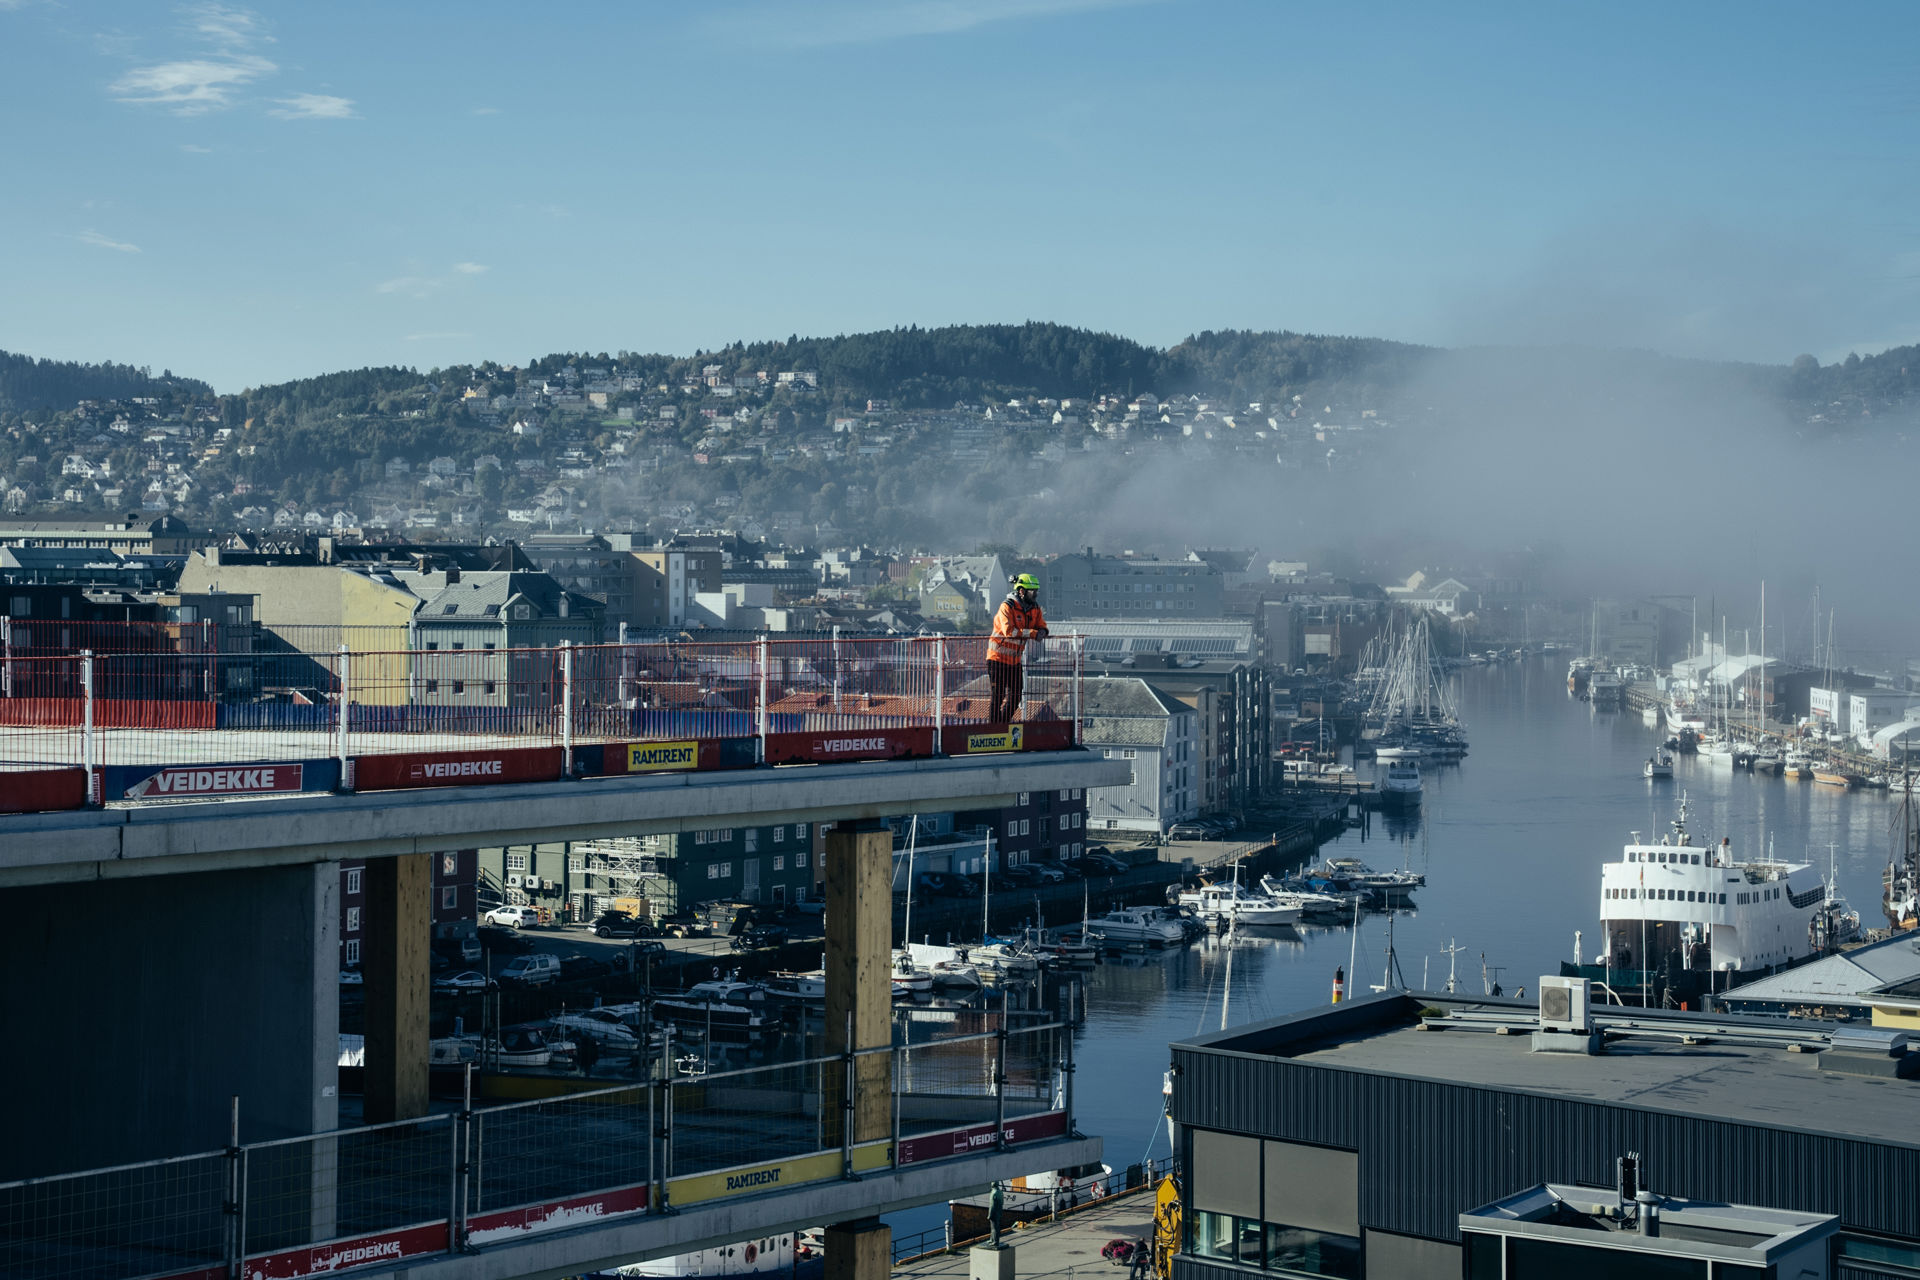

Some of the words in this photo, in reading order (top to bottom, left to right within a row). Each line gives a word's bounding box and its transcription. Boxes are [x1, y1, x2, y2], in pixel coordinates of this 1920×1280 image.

[823, 737, 886, 753] VEIDEKKE
[970, 737, 1007, 749] RAMIRENT
[632, 748, 694, 765] RAMIRENT
[424, 761, 502, 778] VEIDEKKE
[156, 769, 275, 792] VEIDEKKE
[969, 1128, 1015, 1147] VEIDEKE
[726, 1168, 781, 1190] RAMIRENT
[333, 1240, 400, 1263] VEIDEKKE
